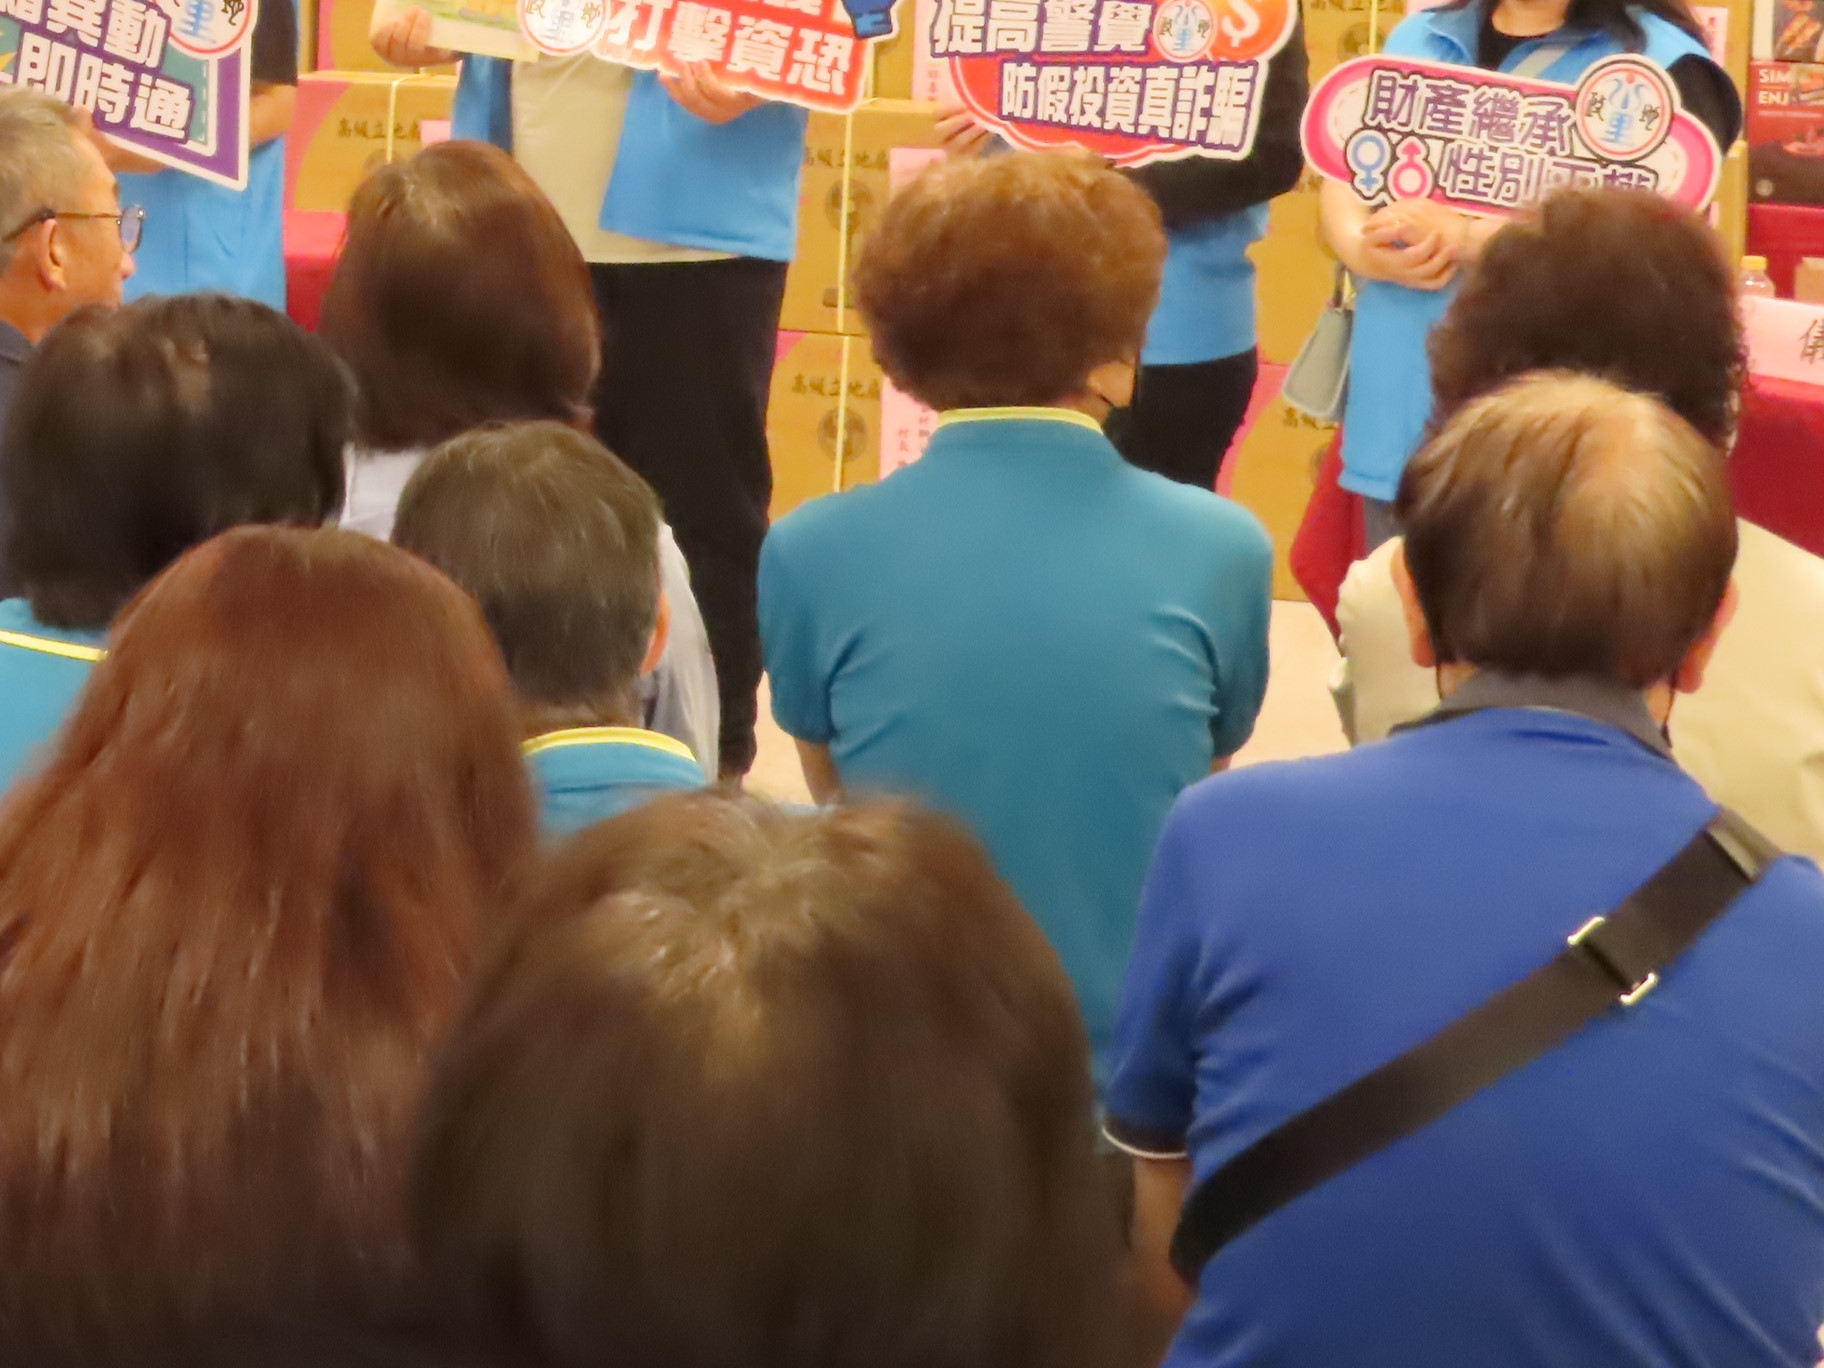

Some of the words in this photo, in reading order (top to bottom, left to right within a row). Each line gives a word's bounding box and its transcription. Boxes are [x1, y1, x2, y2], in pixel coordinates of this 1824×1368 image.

[18, 31, 193, 139] 即時通
[1367, 70, 1574, 155] 財產繼承
